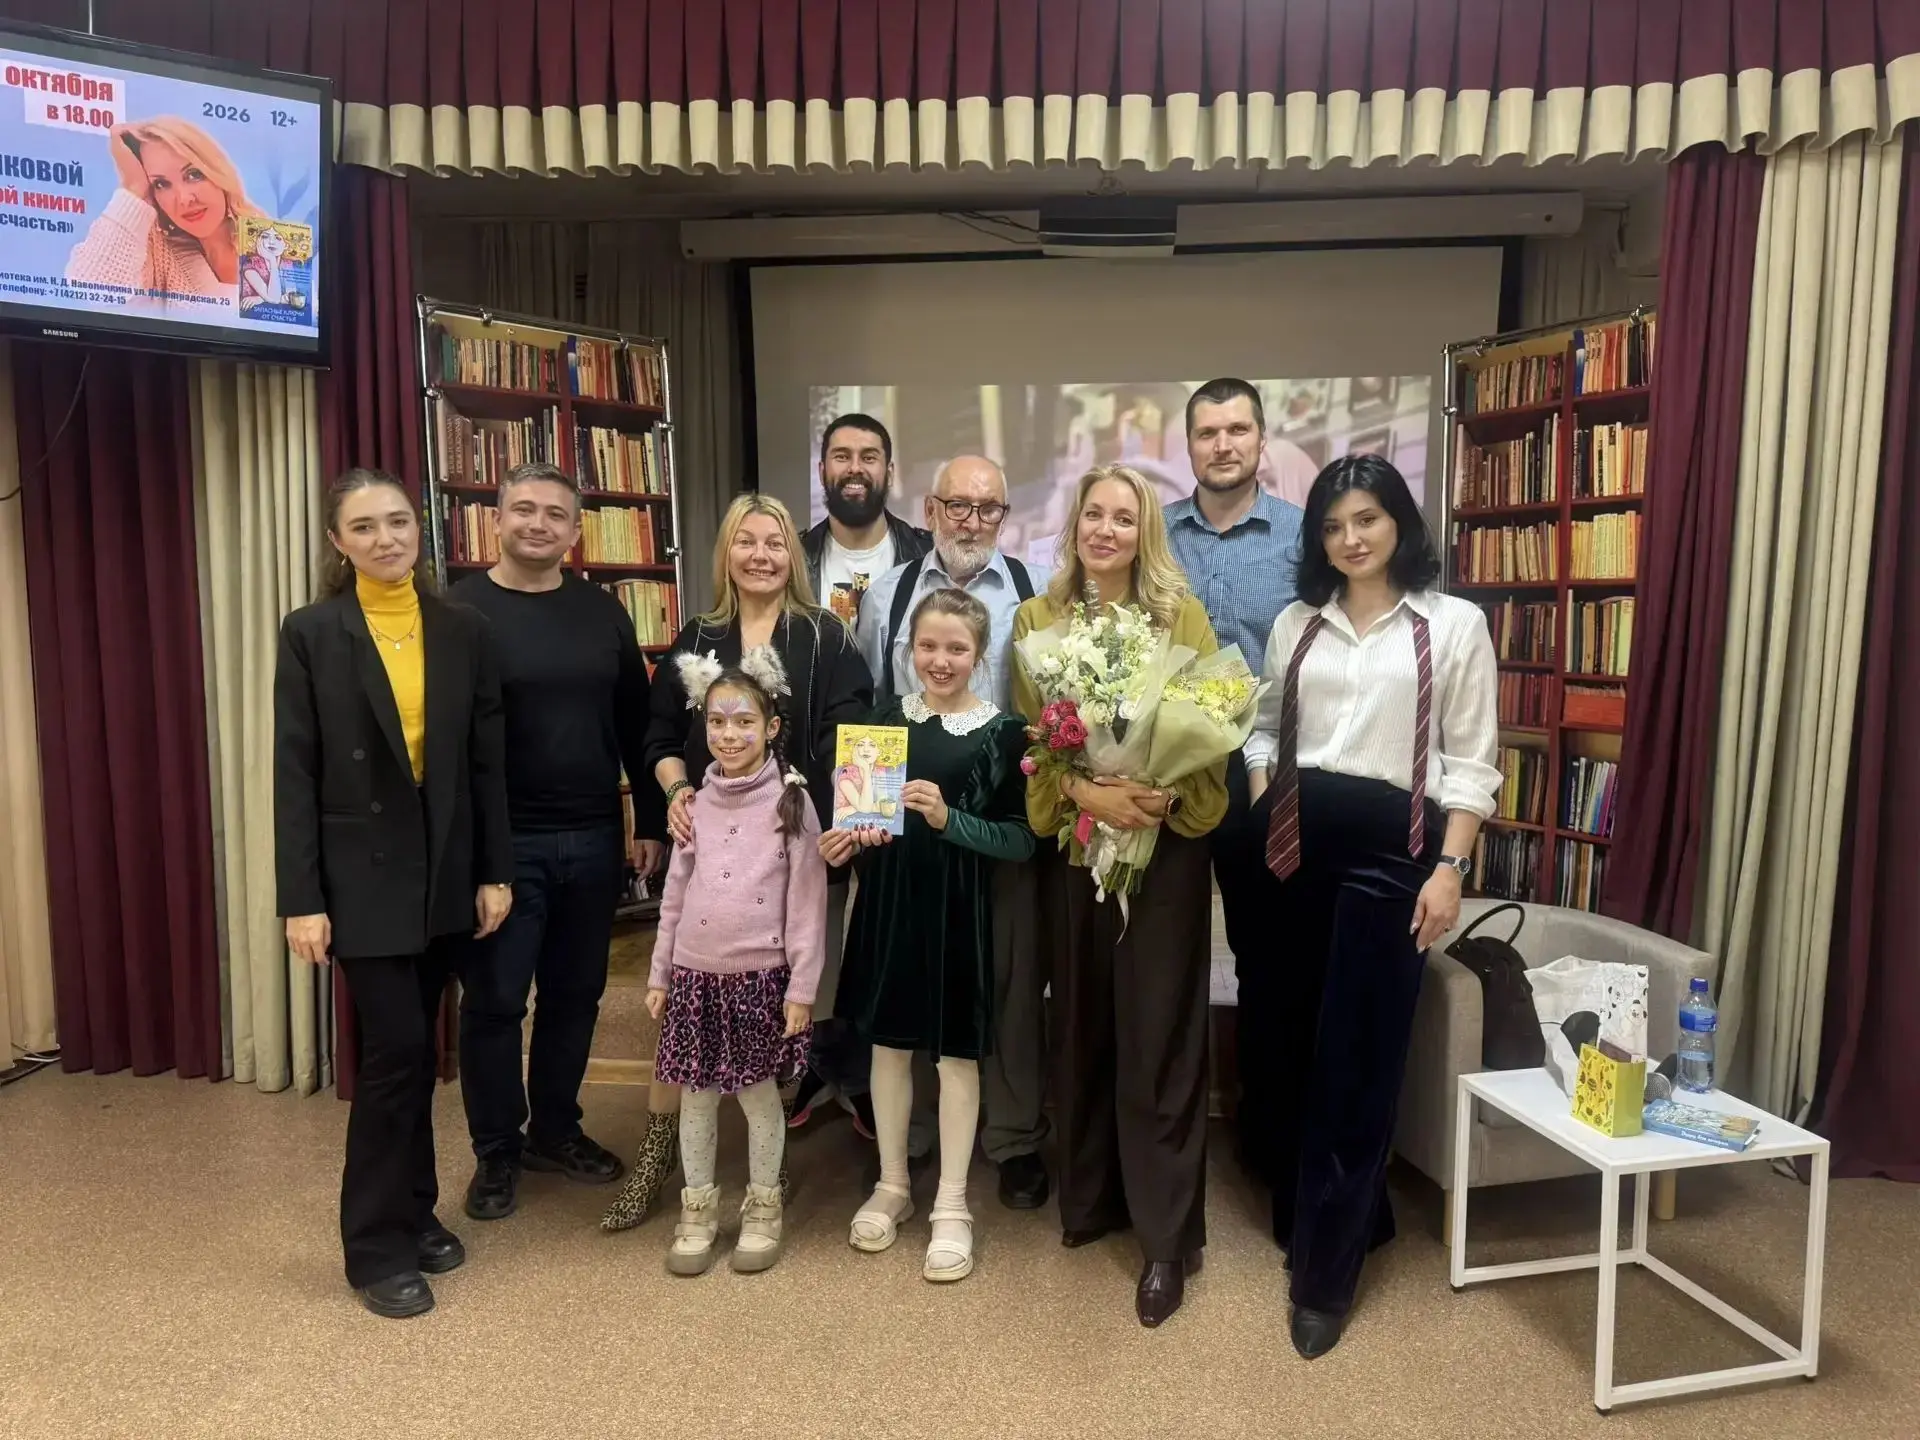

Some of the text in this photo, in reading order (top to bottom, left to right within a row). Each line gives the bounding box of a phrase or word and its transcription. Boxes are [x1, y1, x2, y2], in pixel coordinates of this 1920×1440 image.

[6, 66, 113, 102] октября
[47, 104, 114, 129] в 18.00
[203, 102, 297, 127] 2026 12+
[0, 153, 84, 188] КОВОЙ
[33, 276, 49, 284] им.
[50, 276, 59, 286] Н.
[60, 278, 70, 287] Д.
[219, 297, 230, 306] 25
[49, 288, 59, 297] +7
[60, 289, 87, 300] (4212)
[89, 293, 126, 305] 32-24-15
[43, 328, 79, 338] SAMSUNG
